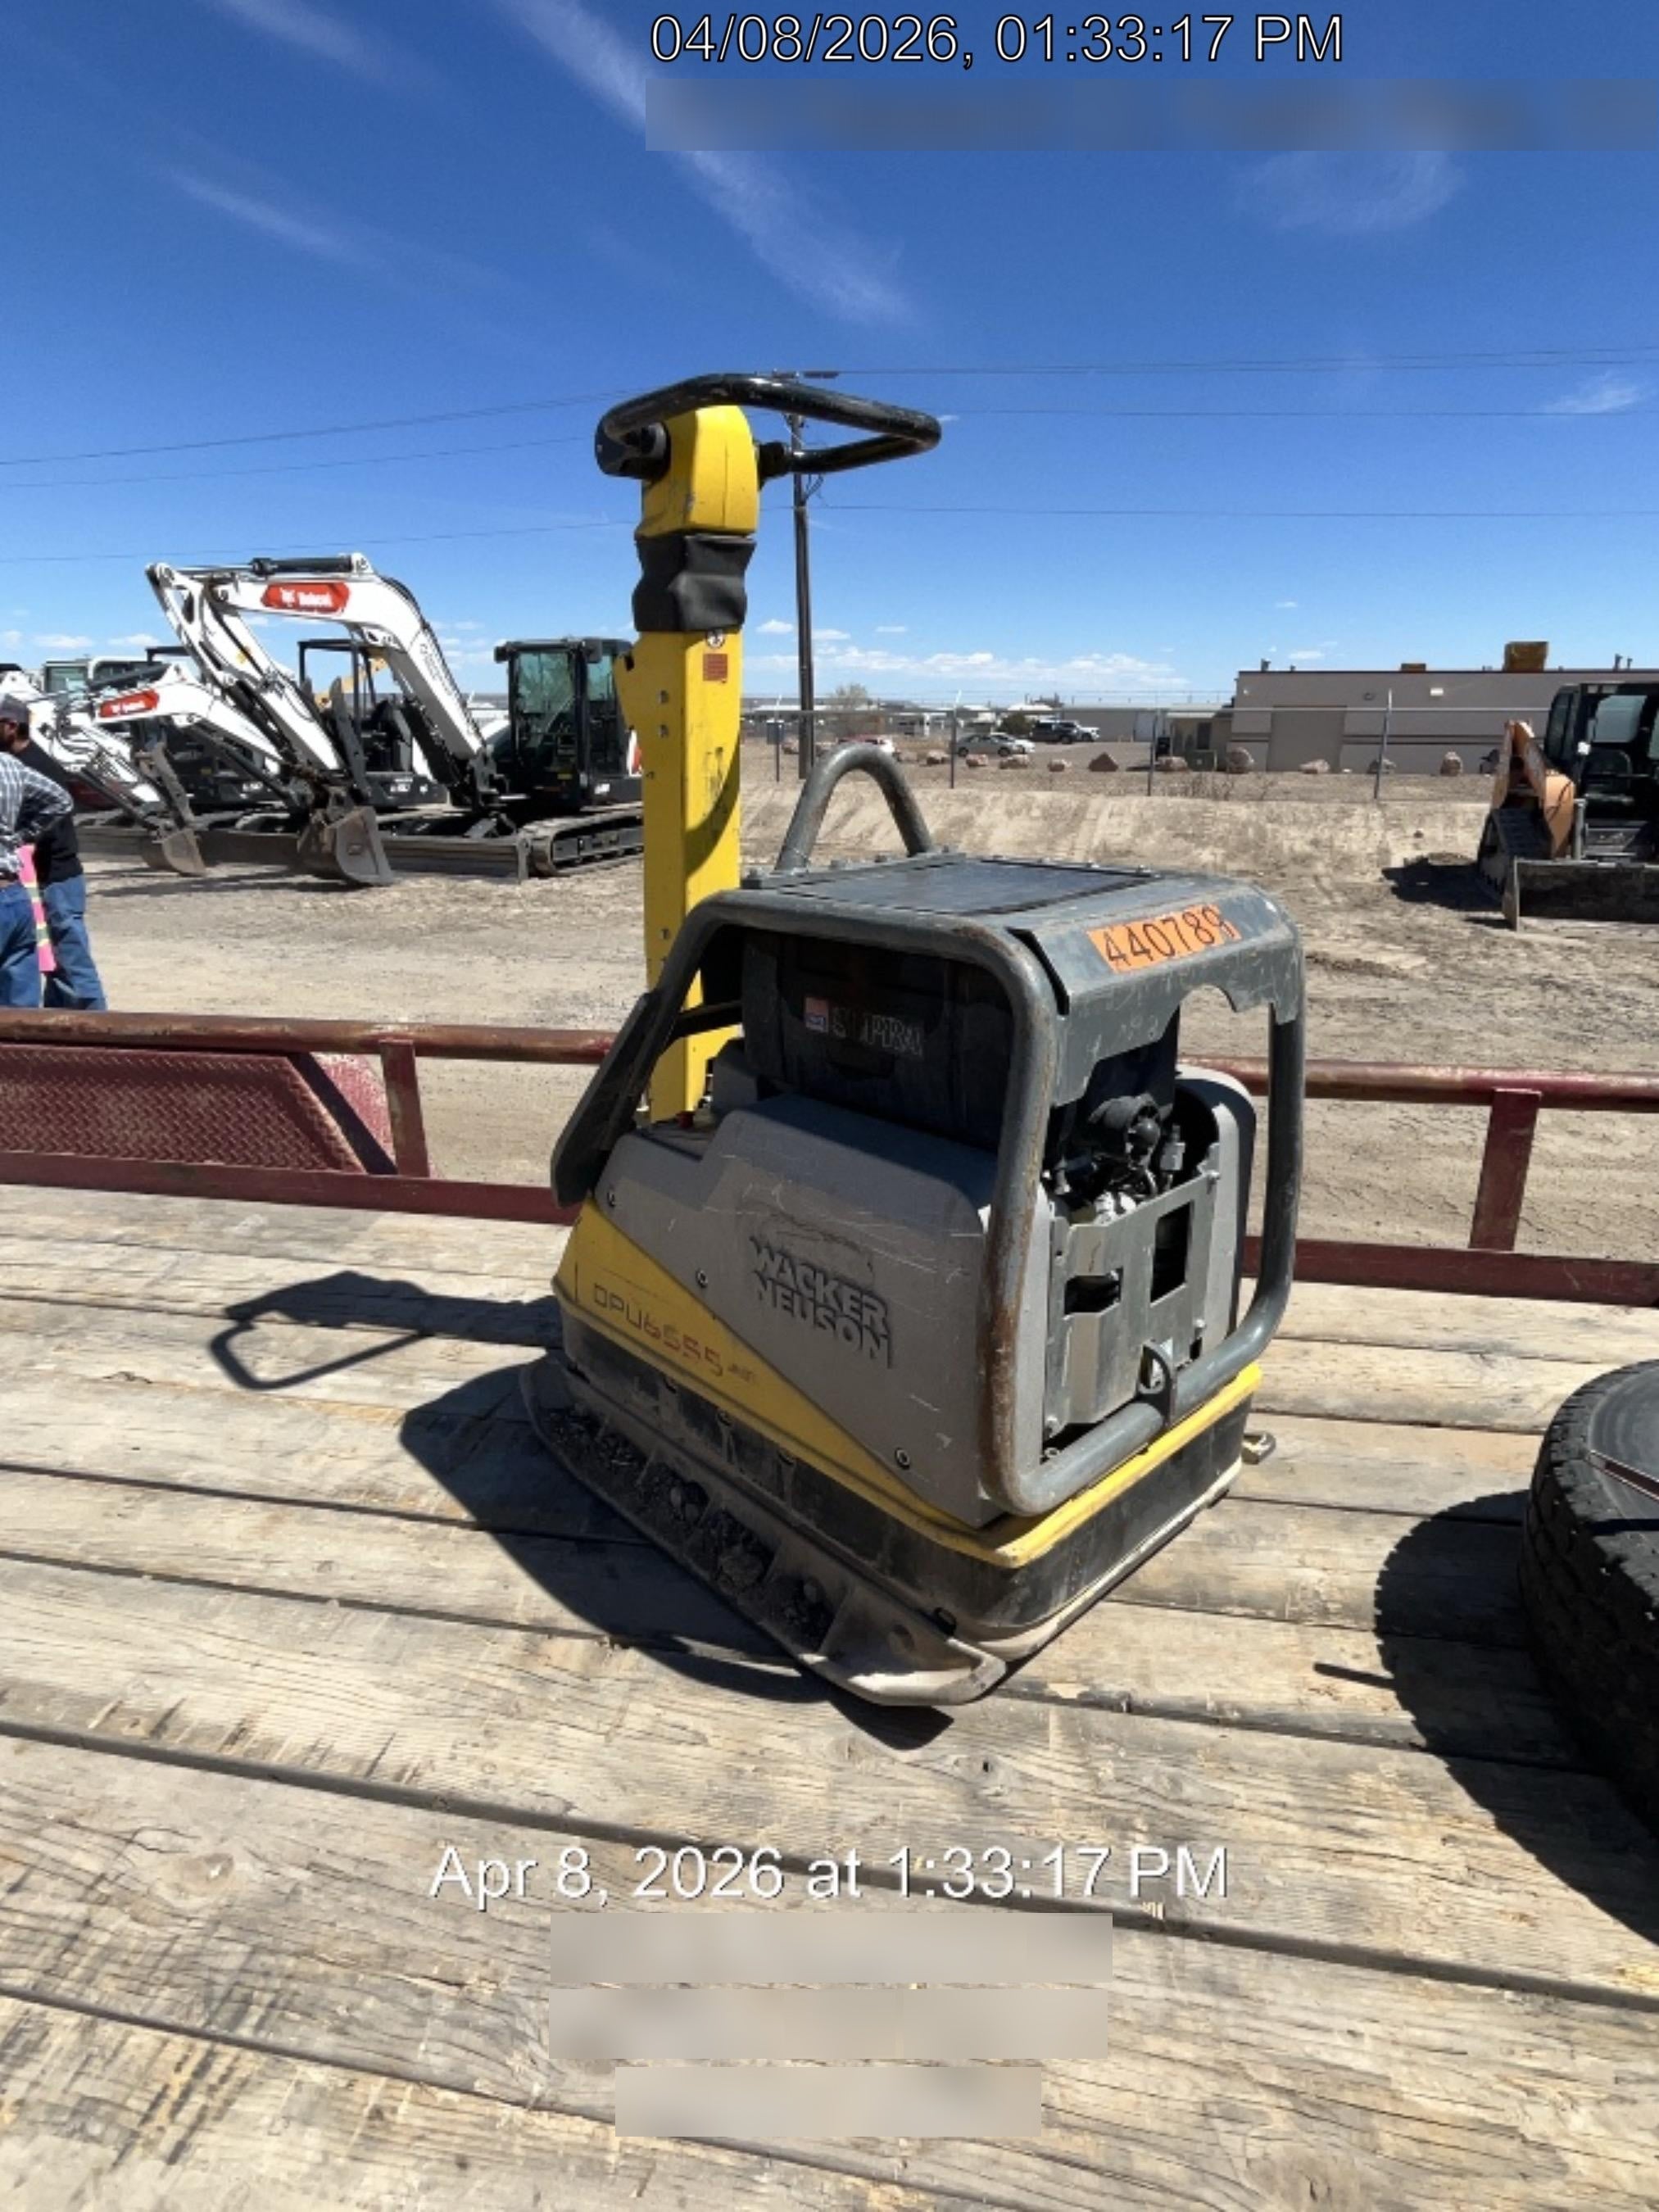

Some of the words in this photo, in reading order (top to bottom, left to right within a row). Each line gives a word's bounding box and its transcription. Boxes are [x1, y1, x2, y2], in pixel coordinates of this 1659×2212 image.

[1102, 905, 1236, 967] 440789
[593, 1282, 724, 1378] DPU6555
[749, 1235, 891, 1340] WACKER
[753, 1269, 893, 1370] NEUSON
